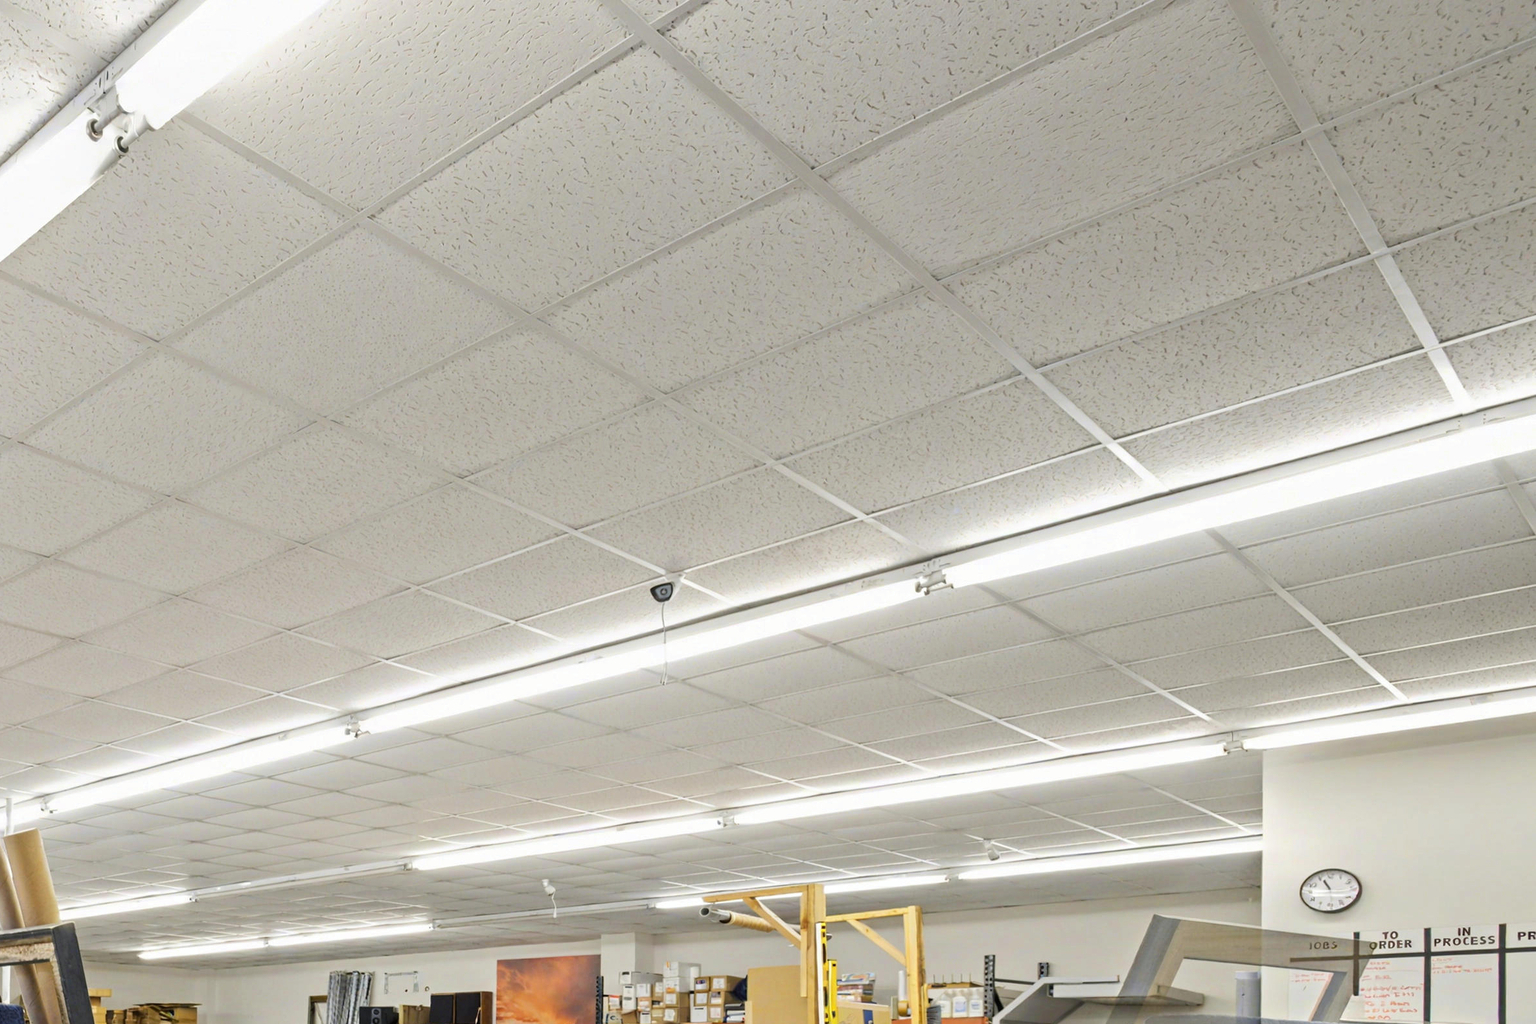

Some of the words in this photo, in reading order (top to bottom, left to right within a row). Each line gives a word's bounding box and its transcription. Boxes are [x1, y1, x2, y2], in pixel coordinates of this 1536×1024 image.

[1382, 931, 1398, 940] TO
[1457, 927, 1471, 936] IN
[1369, 940, 1412, 950] ORDER
[1433, 935, 1496, 947] PROCESS
